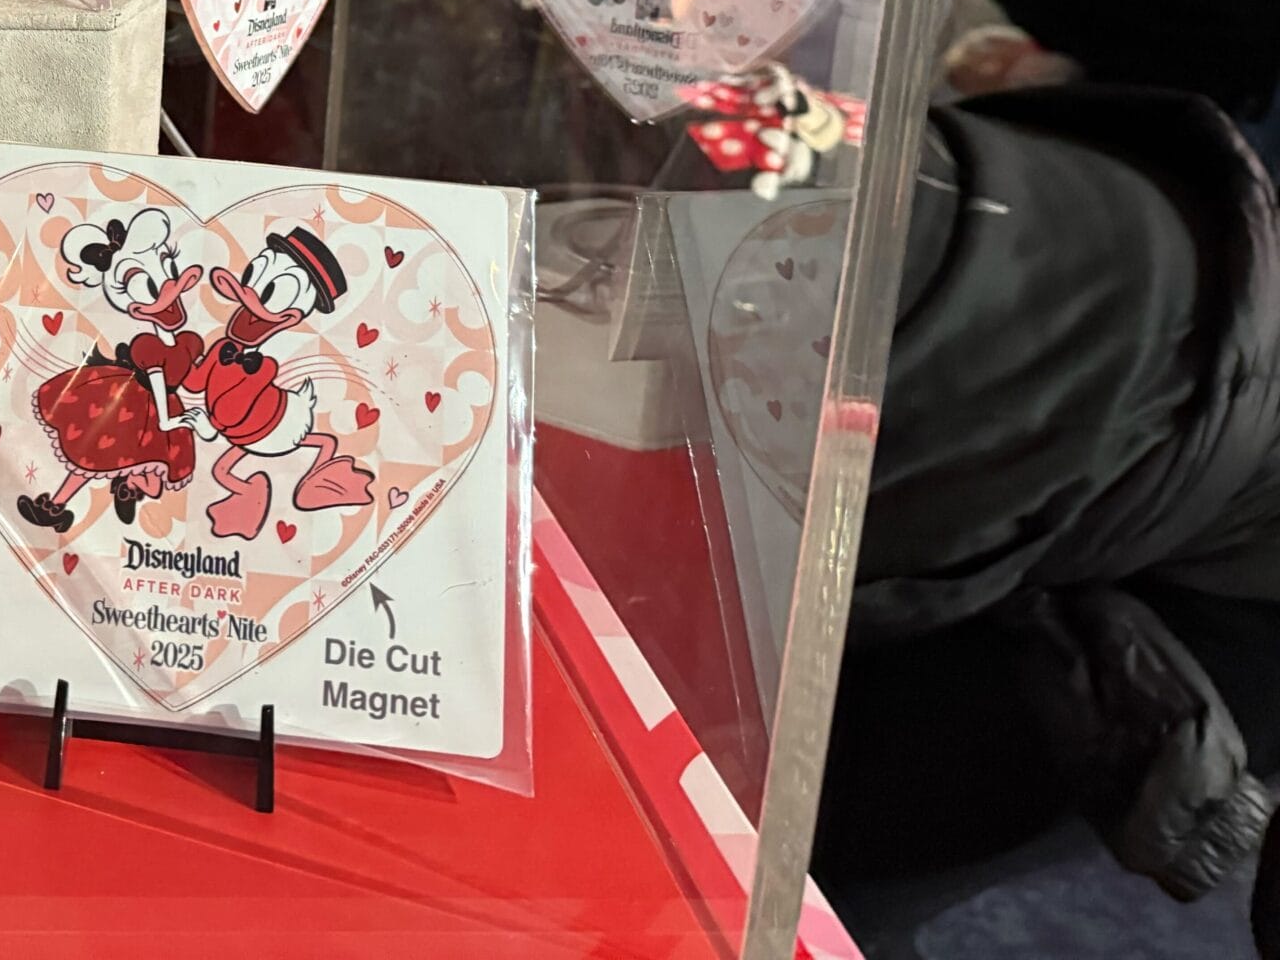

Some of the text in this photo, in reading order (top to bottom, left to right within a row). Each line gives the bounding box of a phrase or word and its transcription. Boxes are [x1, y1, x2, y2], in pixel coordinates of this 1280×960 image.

[247, 9, 287, 36] Disneyland
[232, 48, 277, 75] Sweethearts
[412, 498, 429, 517] Made
[432, 478, 446, 494] USA
[123, 536, 242, 579] Disneyland
[123, 578, 241, 603] AFTER DARK
[91, 597, 268, 643] Sweethearts Nite
[150, 640, 204, 671] 2025
[324, 637, 443, 677] Die Cut
[322, 680, 442, 719] Magnet
